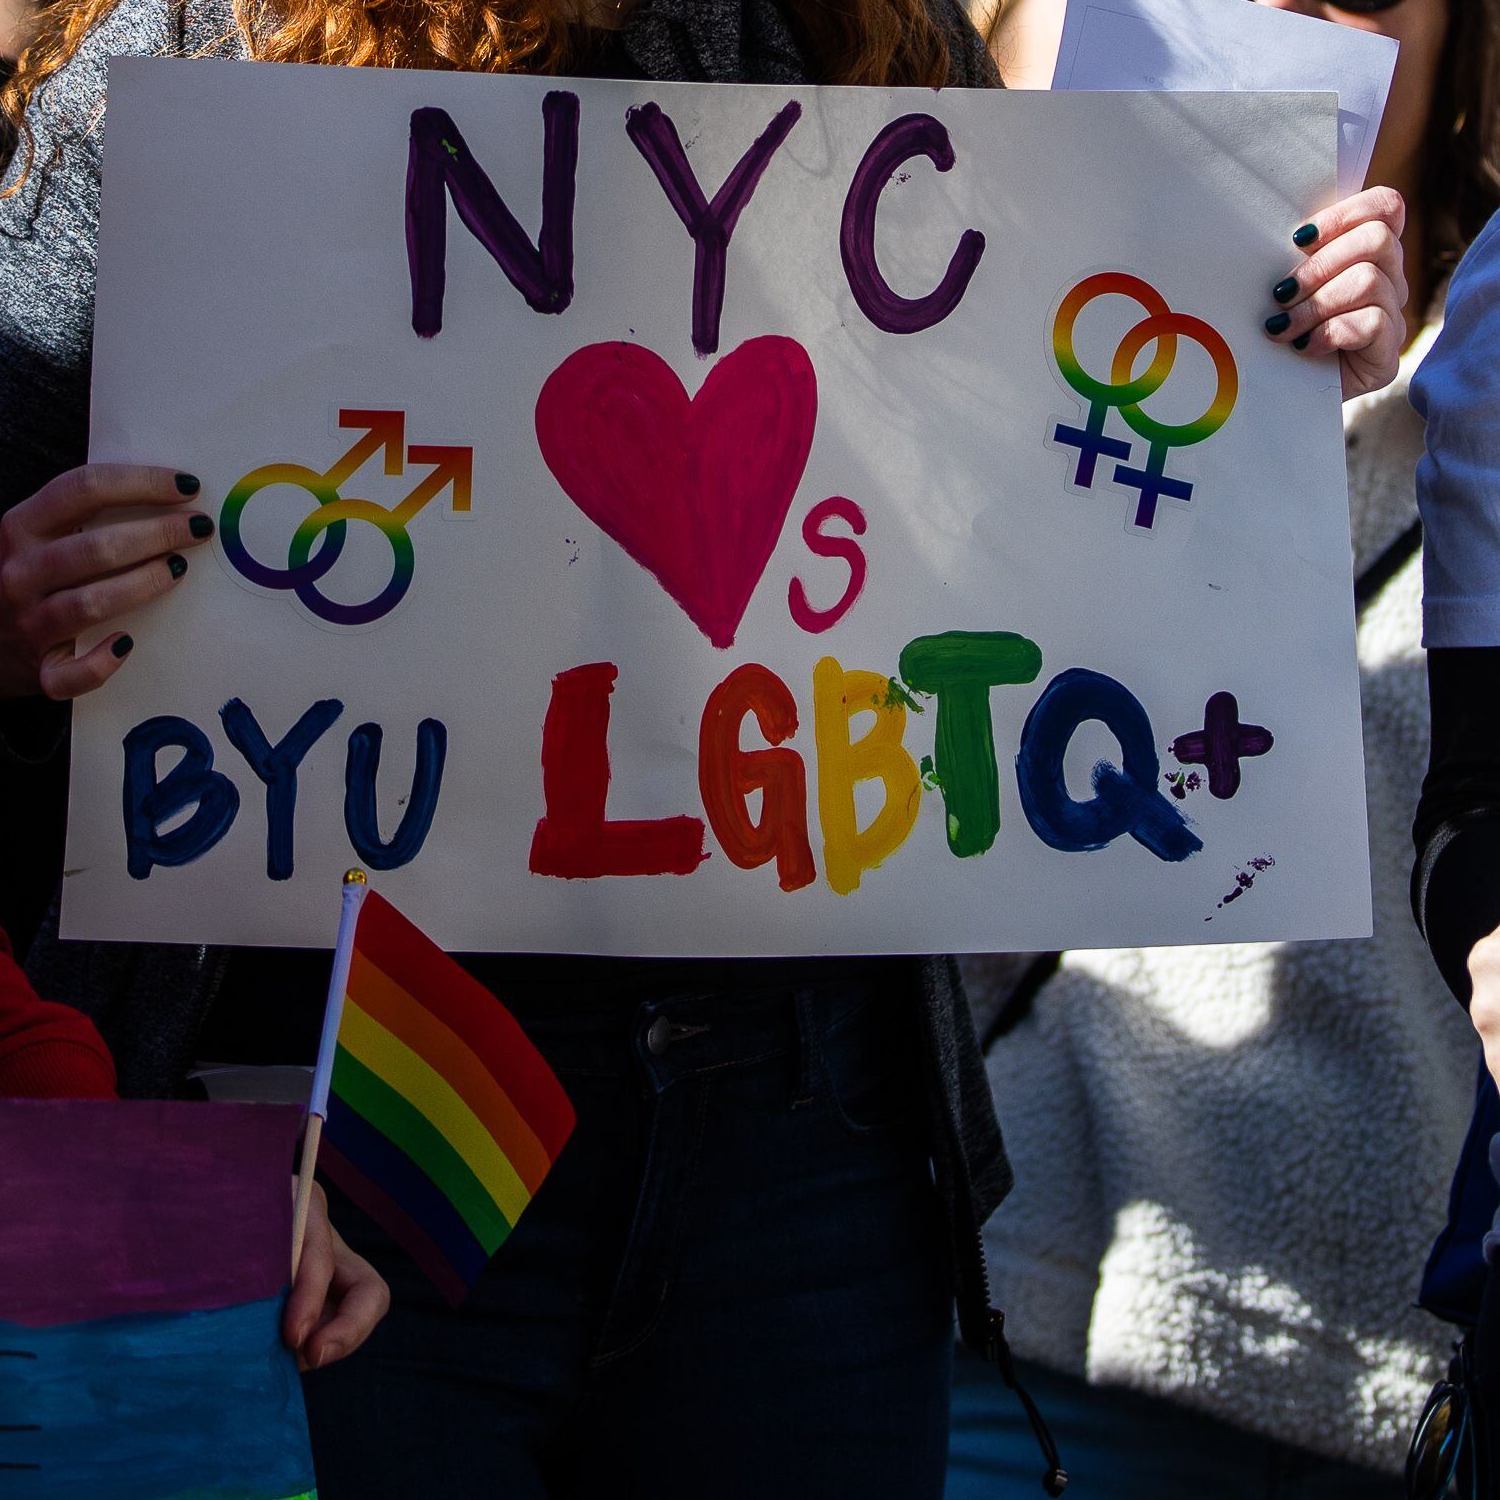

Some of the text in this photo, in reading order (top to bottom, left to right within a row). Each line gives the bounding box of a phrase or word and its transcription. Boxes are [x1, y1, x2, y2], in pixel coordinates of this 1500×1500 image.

[405, 90, 985, 358] NYC
[123, 631, 1274, 896] BYU LGBTQ+
